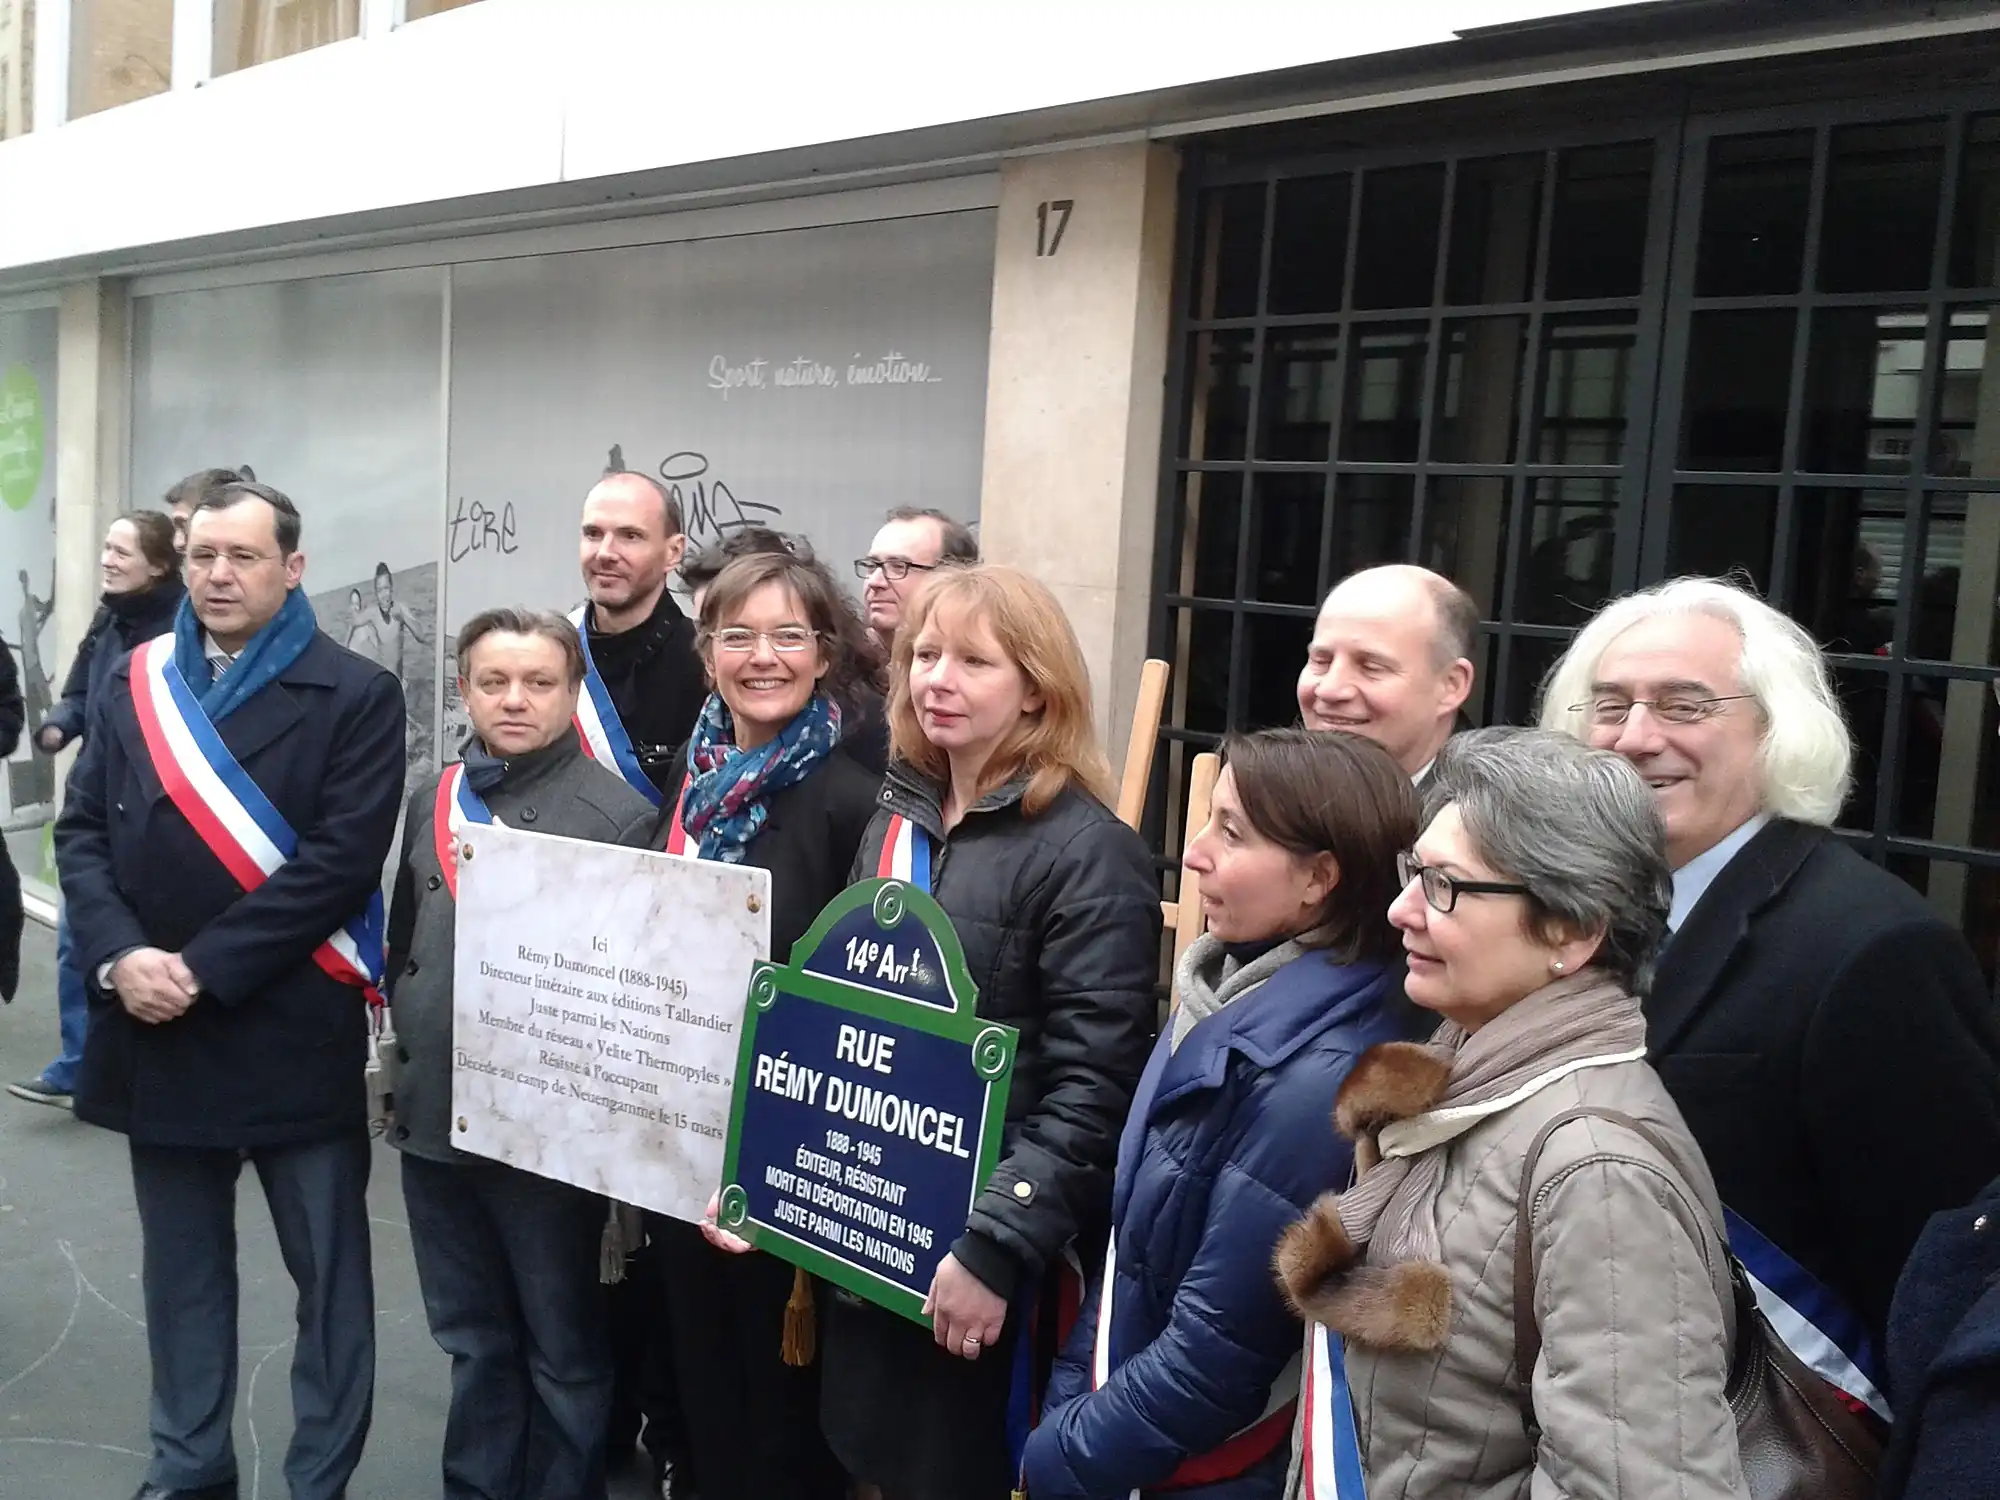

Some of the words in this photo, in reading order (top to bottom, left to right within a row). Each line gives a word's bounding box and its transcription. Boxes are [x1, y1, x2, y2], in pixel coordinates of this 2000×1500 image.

[1037, 199, 1073, 257] 17
[707, 354, 769, 401] Sport,
[775, 356, 840, 388] nature,
[518, 945, 550, 969] Rémy
[554, 953, 615, 980] Dumoncel
[619, 968, 688, 1000] (1888-1945)
[592, 935, 608, 953] Ici
[480, 961, 532, 986] Directeur
[535, 974, 584, 997] littéraire
[587, 989, 608, 1005] aux
[612, 992, 661, 1016] éditions
[665, 1003, 733, 1033] Tallandier
[528, 998, 558, 1017] Juste
[562, 1008, 597, 1027] parmi
[601, 1014, 616, 1032] les
[620, 1019, 671, 1045] Nations
[478, 1009, 525, 1034] Membre
[528, 1022, 542, 1039] du
[546, 1028, 584, 1049] réseau
[636, 1049, 720, 1085] Thermopyles
[583, 1062, 590, 1077] à
[836, 1024, 896, 1075] RUE
[501, 1068, 514, 1081] au
[517, 1073, 549, 1095] camp
[552, 1079, 566, 1095] de
[569, 1082, 656, 1121] Neuengamme
[659, 1109, 670, 1125] le
[675, 1113, 687, 1130] 15
[691, 1121, 723, 1140] mars
[754, 1051, 823, 1106] RÉMY
[825, 1076, 970, 1159] DUMONCEL
[795, 1143, 842, 1186] ÉDITEUR,
[844, 1164, 907, 1206] RÉSISTANT
[765, 1165, 797, 1194] MORT
[796, 1177, 811, 1201] EN
[812, 1181, 889, 1232] DÉPORTATION
[888, 1214, 906, 1240] EN
[907, 1222, 933, 1250] 1945
[774, 1199, 808, 1229] JUSTE
[808, 1214, 842, 1244] PARMI
[842, 1226, 864, 1253] LES
[865, 1236, 915, 1275] NATIONS
